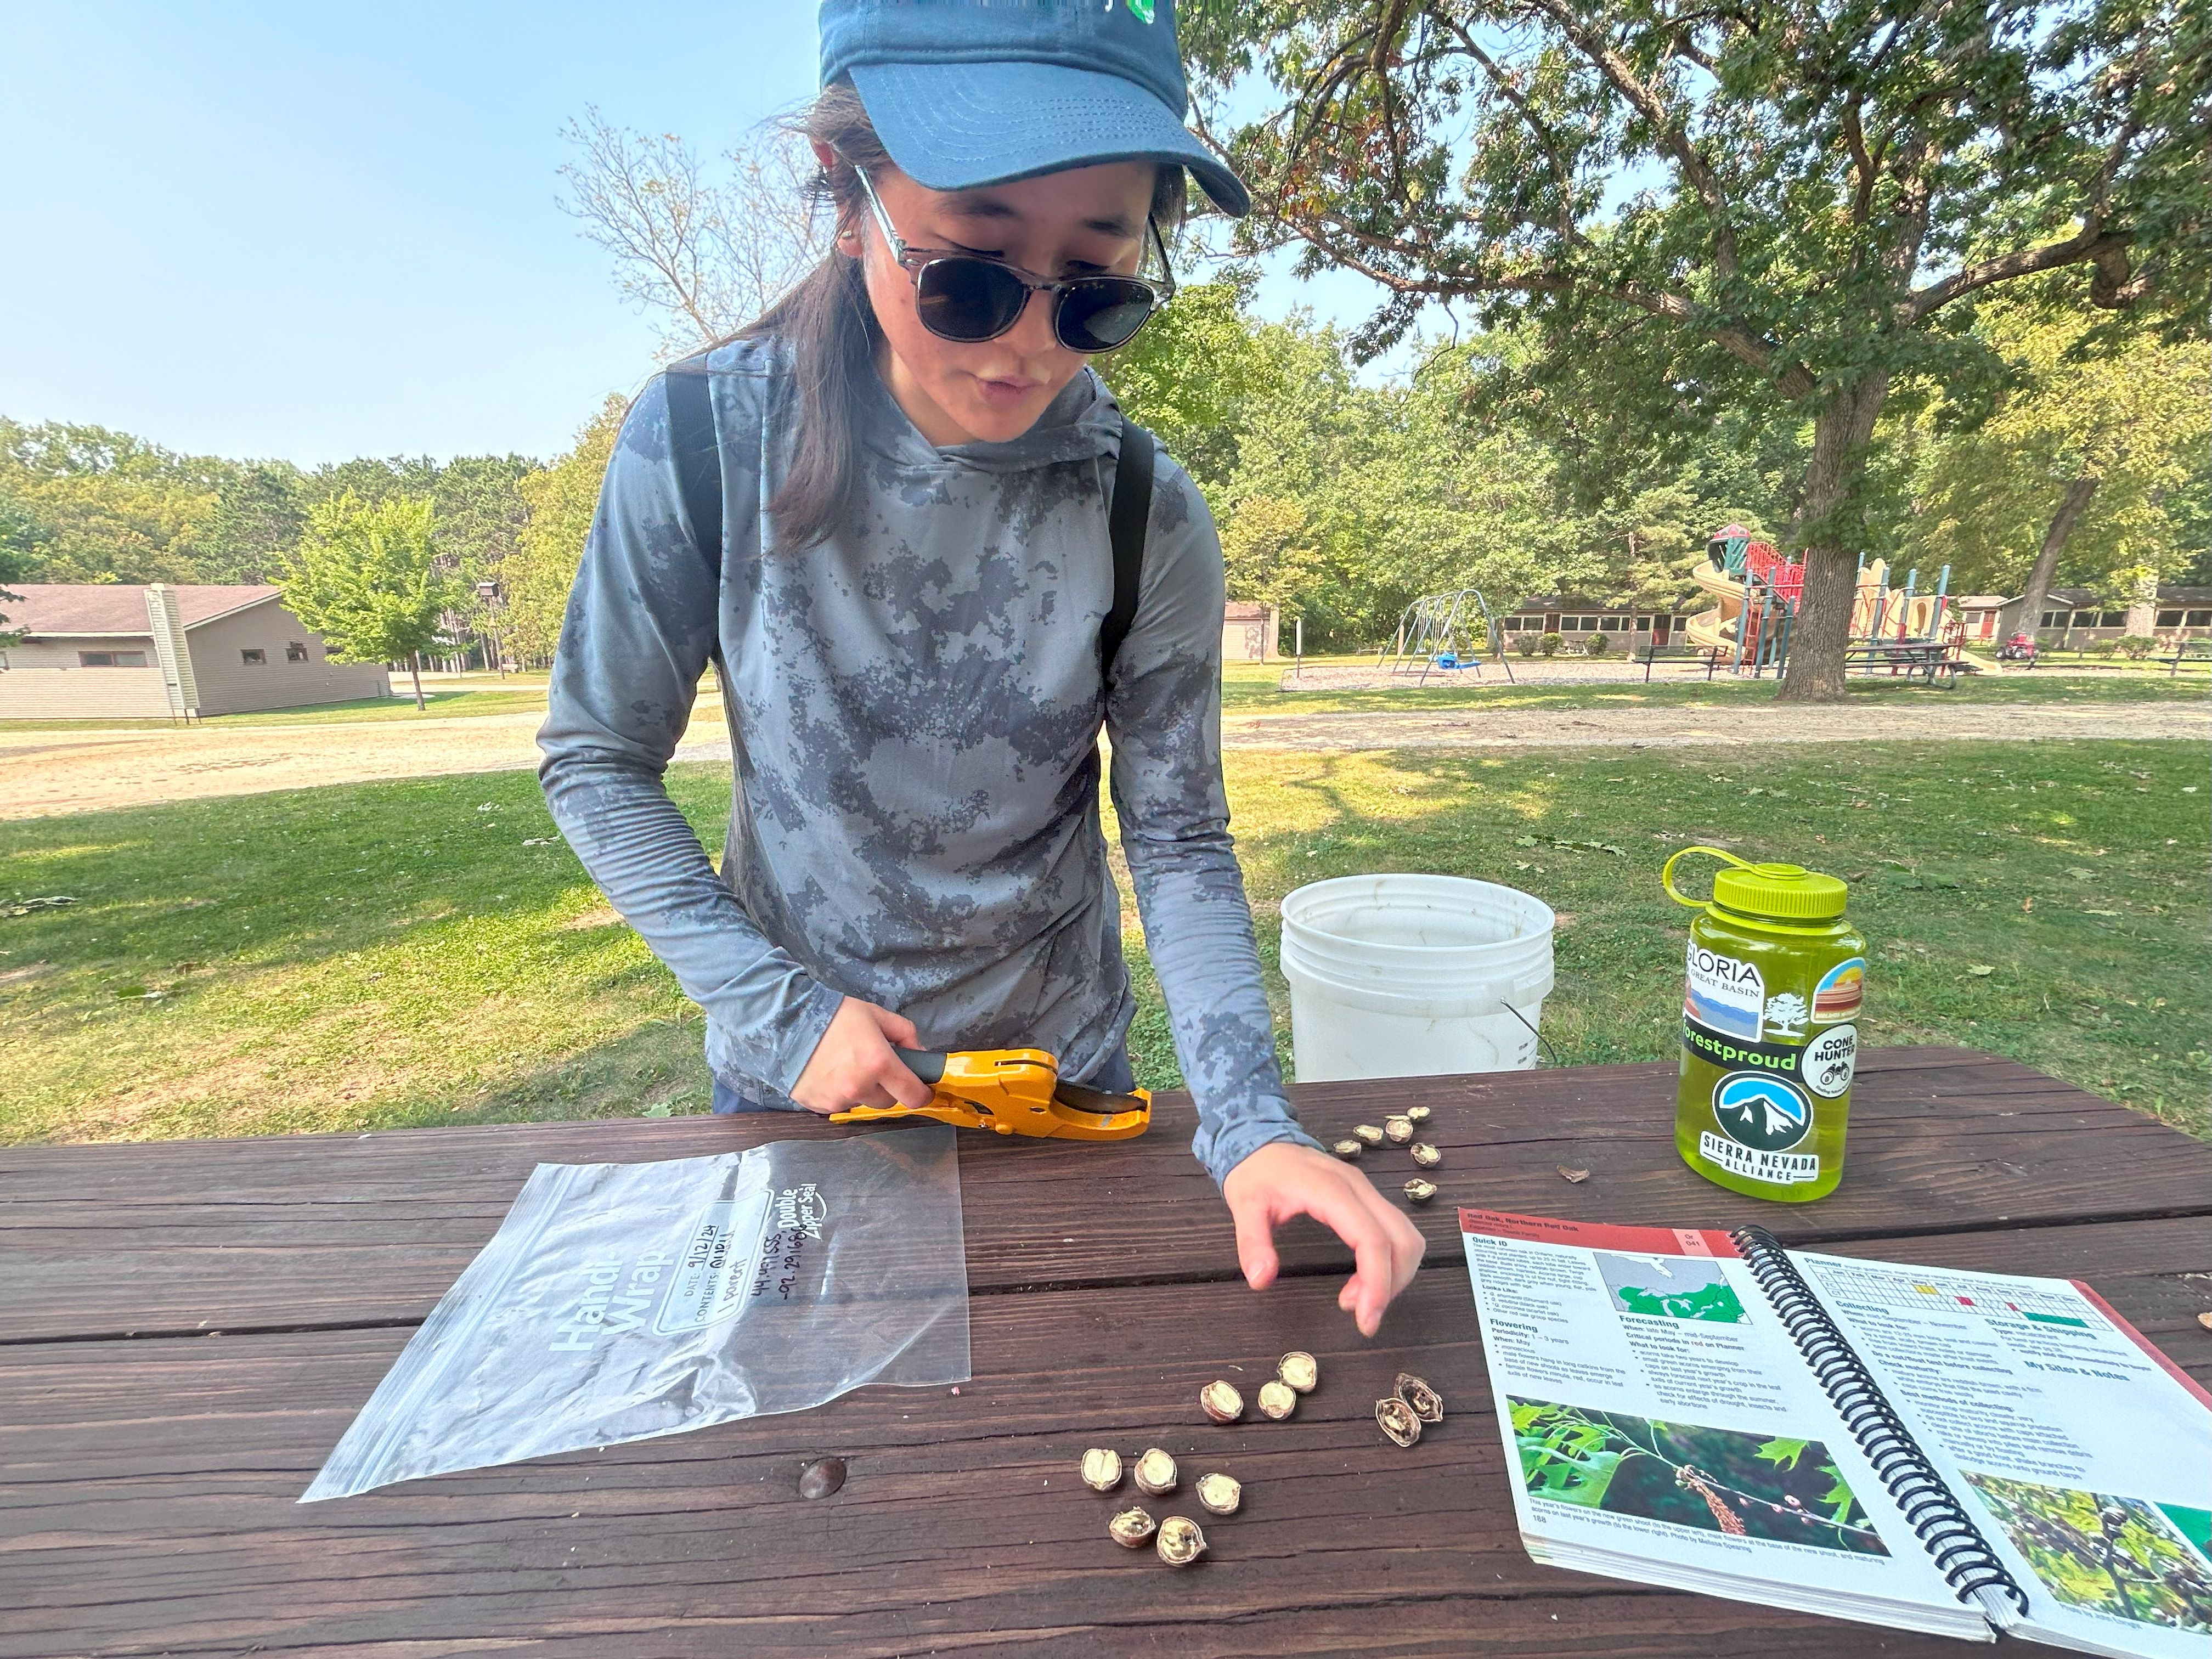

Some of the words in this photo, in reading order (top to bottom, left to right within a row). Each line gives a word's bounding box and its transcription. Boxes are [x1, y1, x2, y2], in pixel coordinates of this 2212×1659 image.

[1691, 969, 1718, 986] GREAT
[1722, 983, 1759, 997] BASIN
[1683, 1018, 1796, 1070] forestproud
[1823, 1035, 1853, 1050] CONE
[1815, 1044, 1855, 1062] HUNTER
[1705, 1135, 1752, 1163] SIERRA
[1760, 1154, 1815, 1170] NEVADA
[1725, 1159, 1791, 1181] ALLIANCE
[798, 1183, 817, 1203] Seal
[775, 1189, 800, 1228] Double
[800, 1205, 822, 1239] Zipper
[1505, 1218, 1542, 1227] Northern
[688, 1224, 716, 1268] 9/12/24
[1472, 1237, 1497, 1245] Quick
[1804, 1257, 1842, 1267] Planner
[602, 1251, 675, 1335] Wrap
[685, 1273, 700, 1296] DATE:
[549, 1251, 623, 1351] Handi-
[695, 1272, 719, 1322] CONTENTS:
[1836, 1300, 1889, 1315] Collecting
[1490, 1318, 1538, 1333] Flowering
[1619, 1315, 1679, 1329] Forecasting
[1492, 1328, 1530, 1338] Periodicity:
[2043, 1326, 2097, 1340] Shipping
[1533, 1515, 1547, 1523] 188
